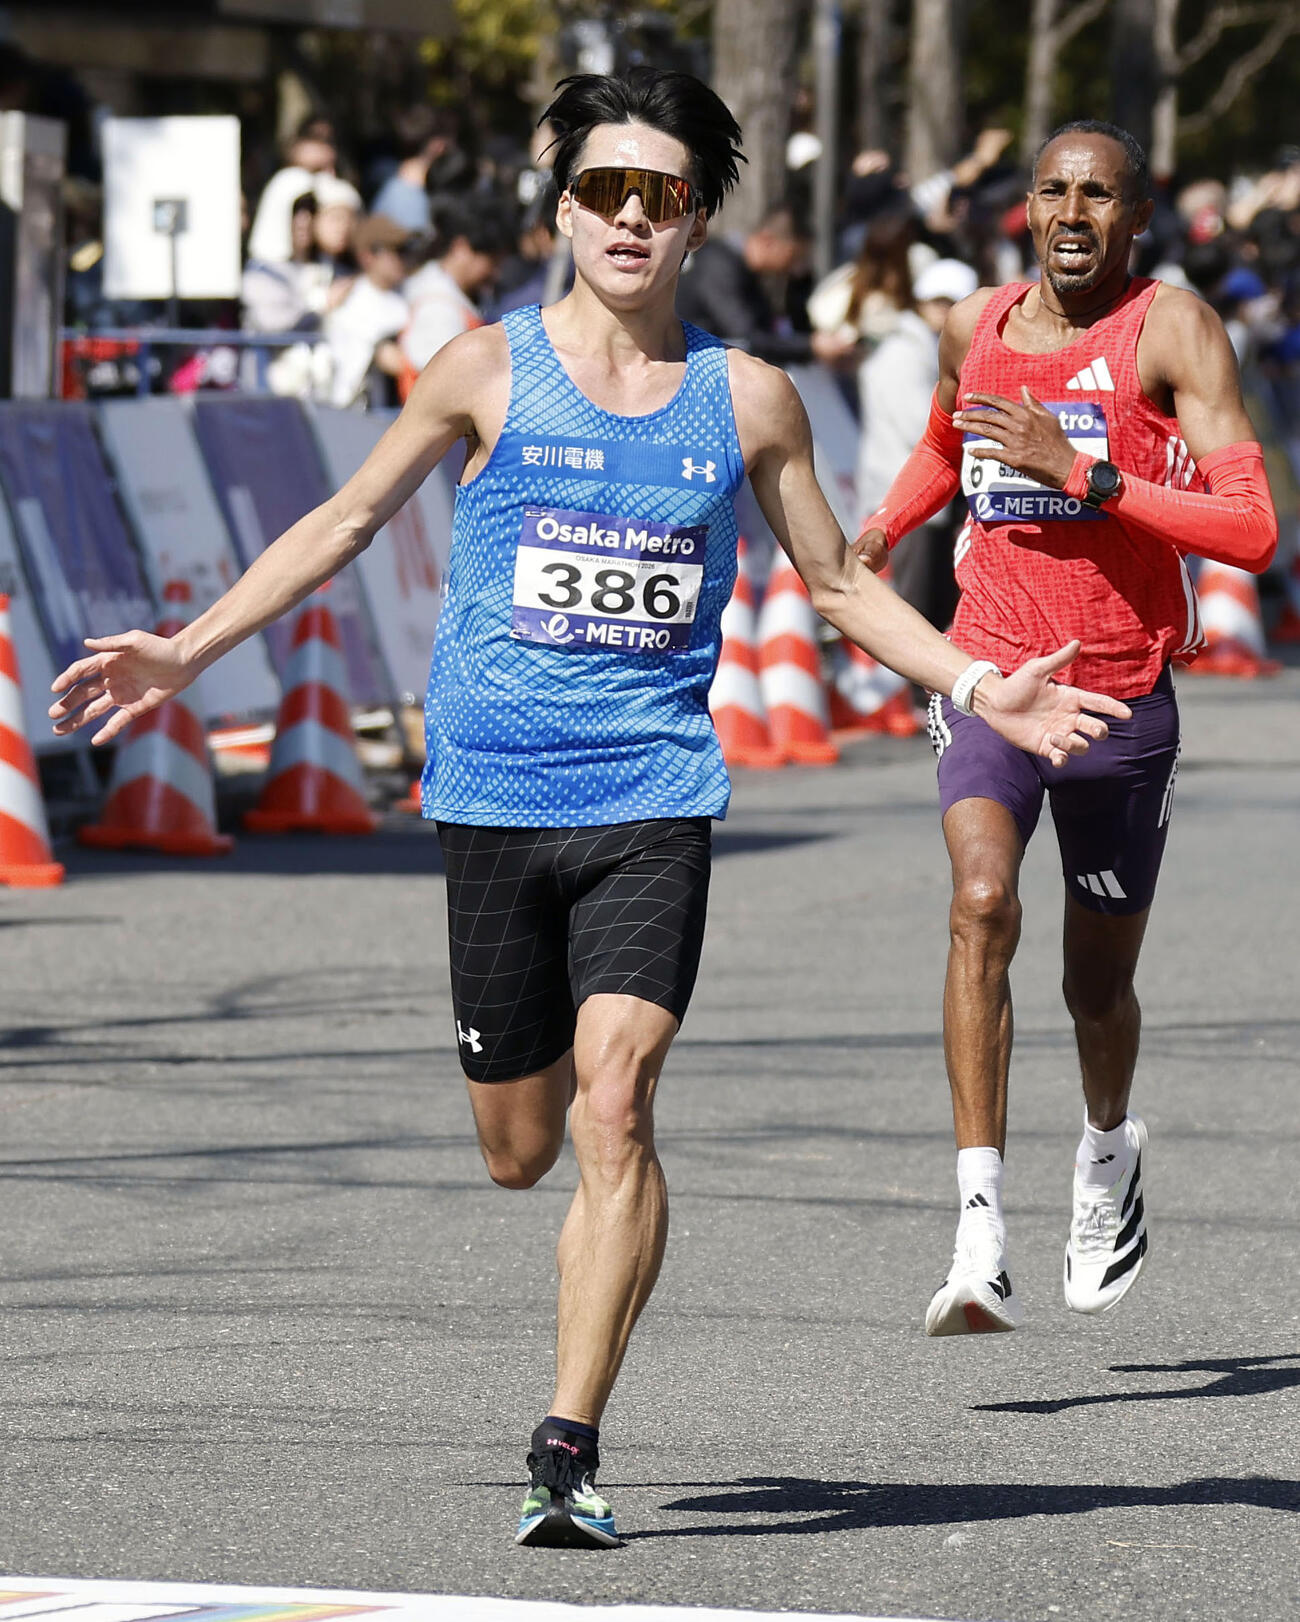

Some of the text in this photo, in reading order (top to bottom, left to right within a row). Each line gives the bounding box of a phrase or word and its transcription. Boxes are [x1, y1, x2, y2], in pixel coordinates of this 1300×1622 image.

[1059, 410, 1094, 431] tro
[521, 444, 606, 471] 安川電機
[536, 517, 696, 555] Osaka Metro
[575, 554, 600, 564] OSAKA
[601, 557, 641, 569] MARATHON
[537, 562, 682, 620] 386
